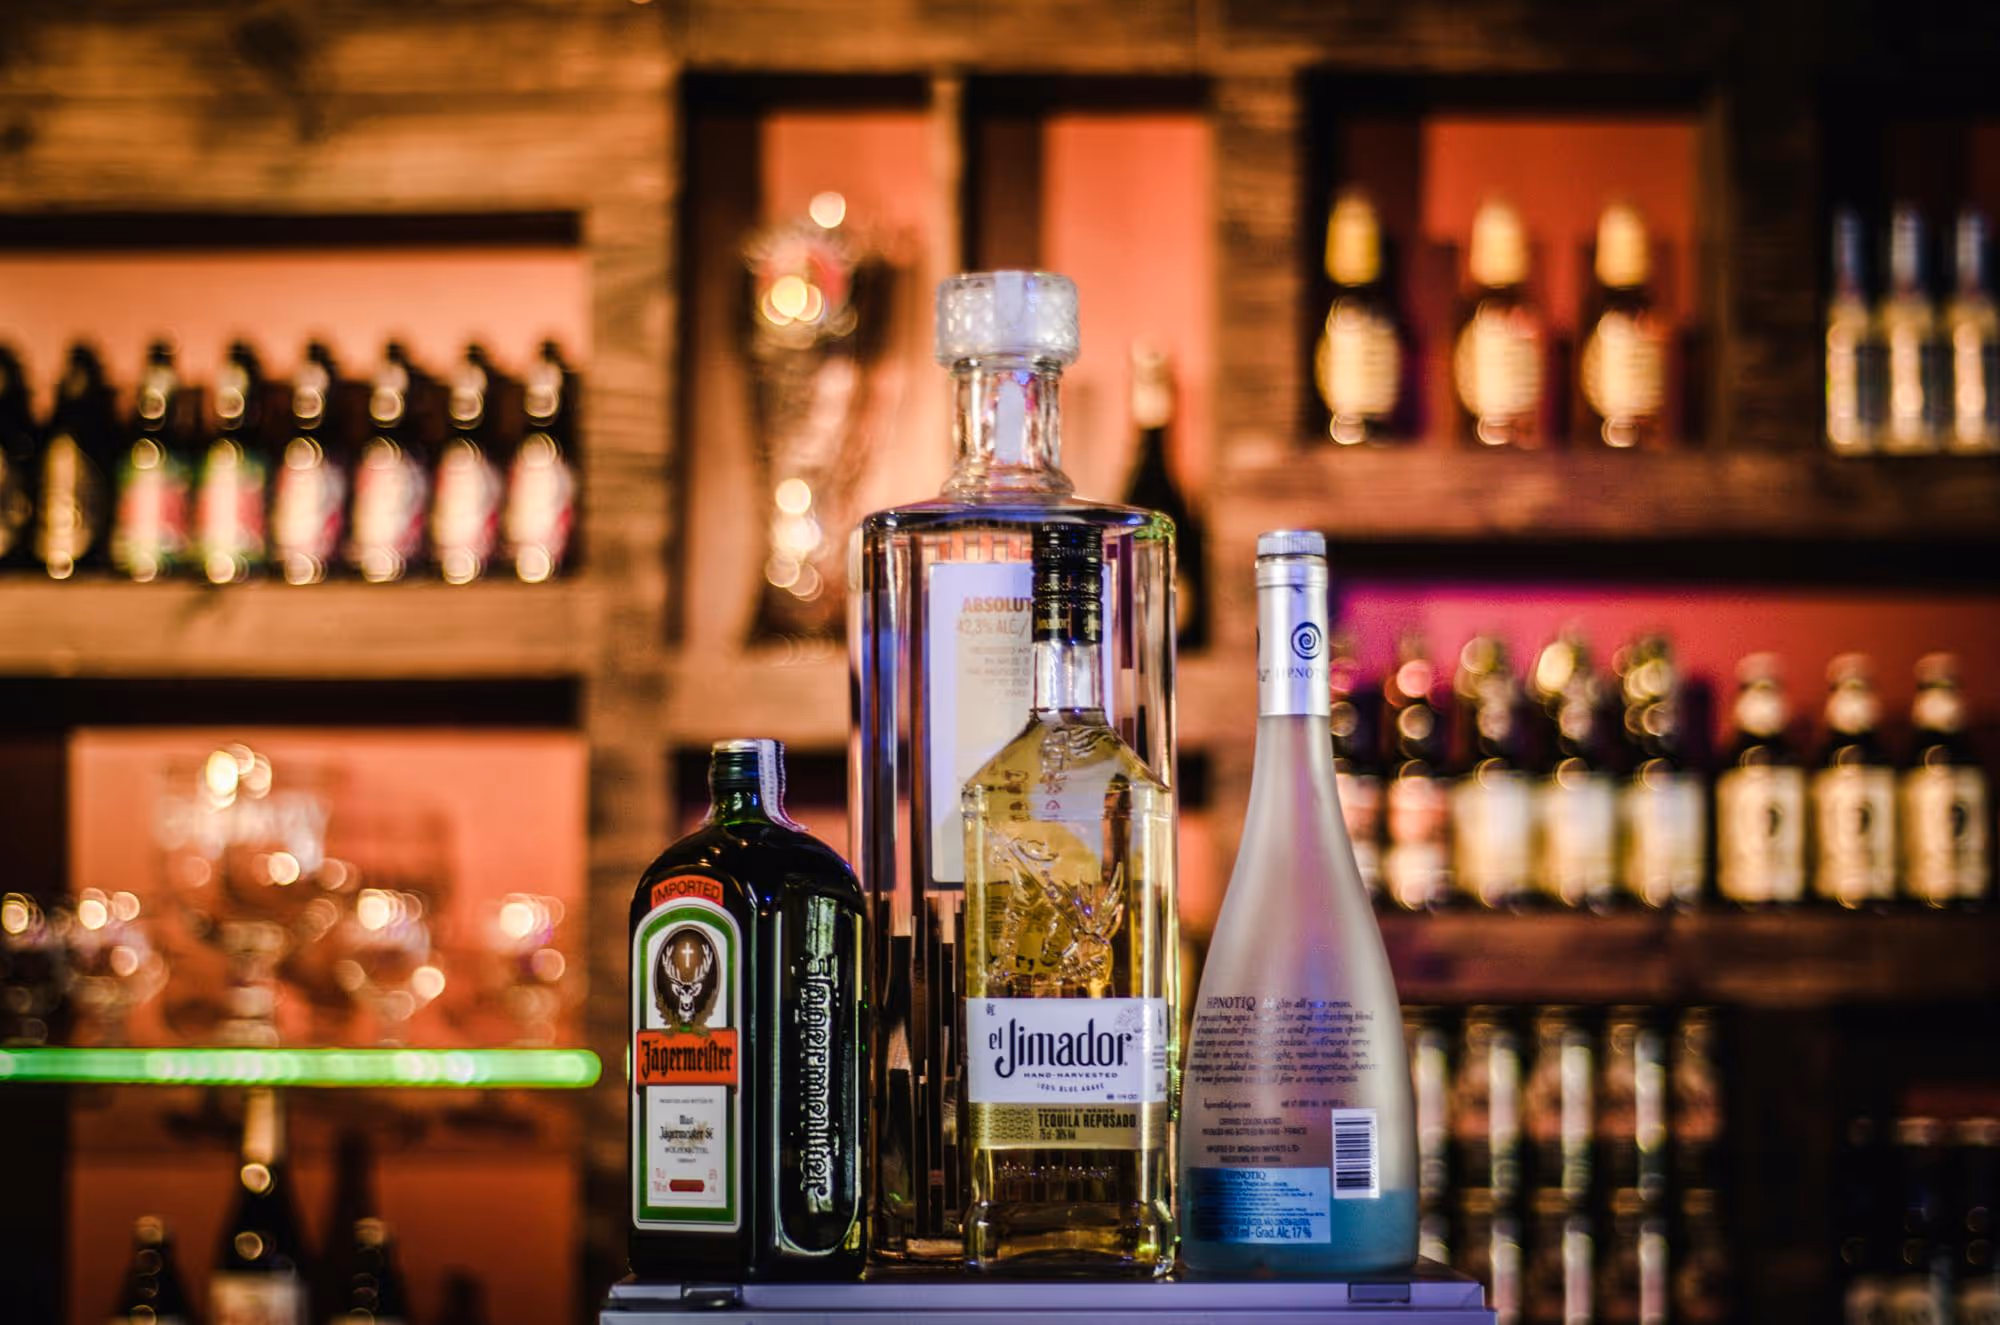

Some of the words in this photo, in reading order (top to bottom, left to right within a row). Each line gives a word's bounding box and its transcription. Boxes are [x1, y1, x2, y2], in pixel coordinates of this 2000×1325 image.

[962, 596, 1032, 613] ABSOLUT
[653, 880, 721, 903] IMPORTED
[988, 1026, 1003, 1050] el
[994, 1017, 1132, 1078] Jimador
[1059, 1085, 1079, 1093] BLUE
[1037, 1113, 1080, 1129] TEQUILA
[1082, 1113, 1137, 1129] REPOSADO
[1255, 1226, 1275, 1238] Grad.
[1291, 1226, 1303, 1239] 17
